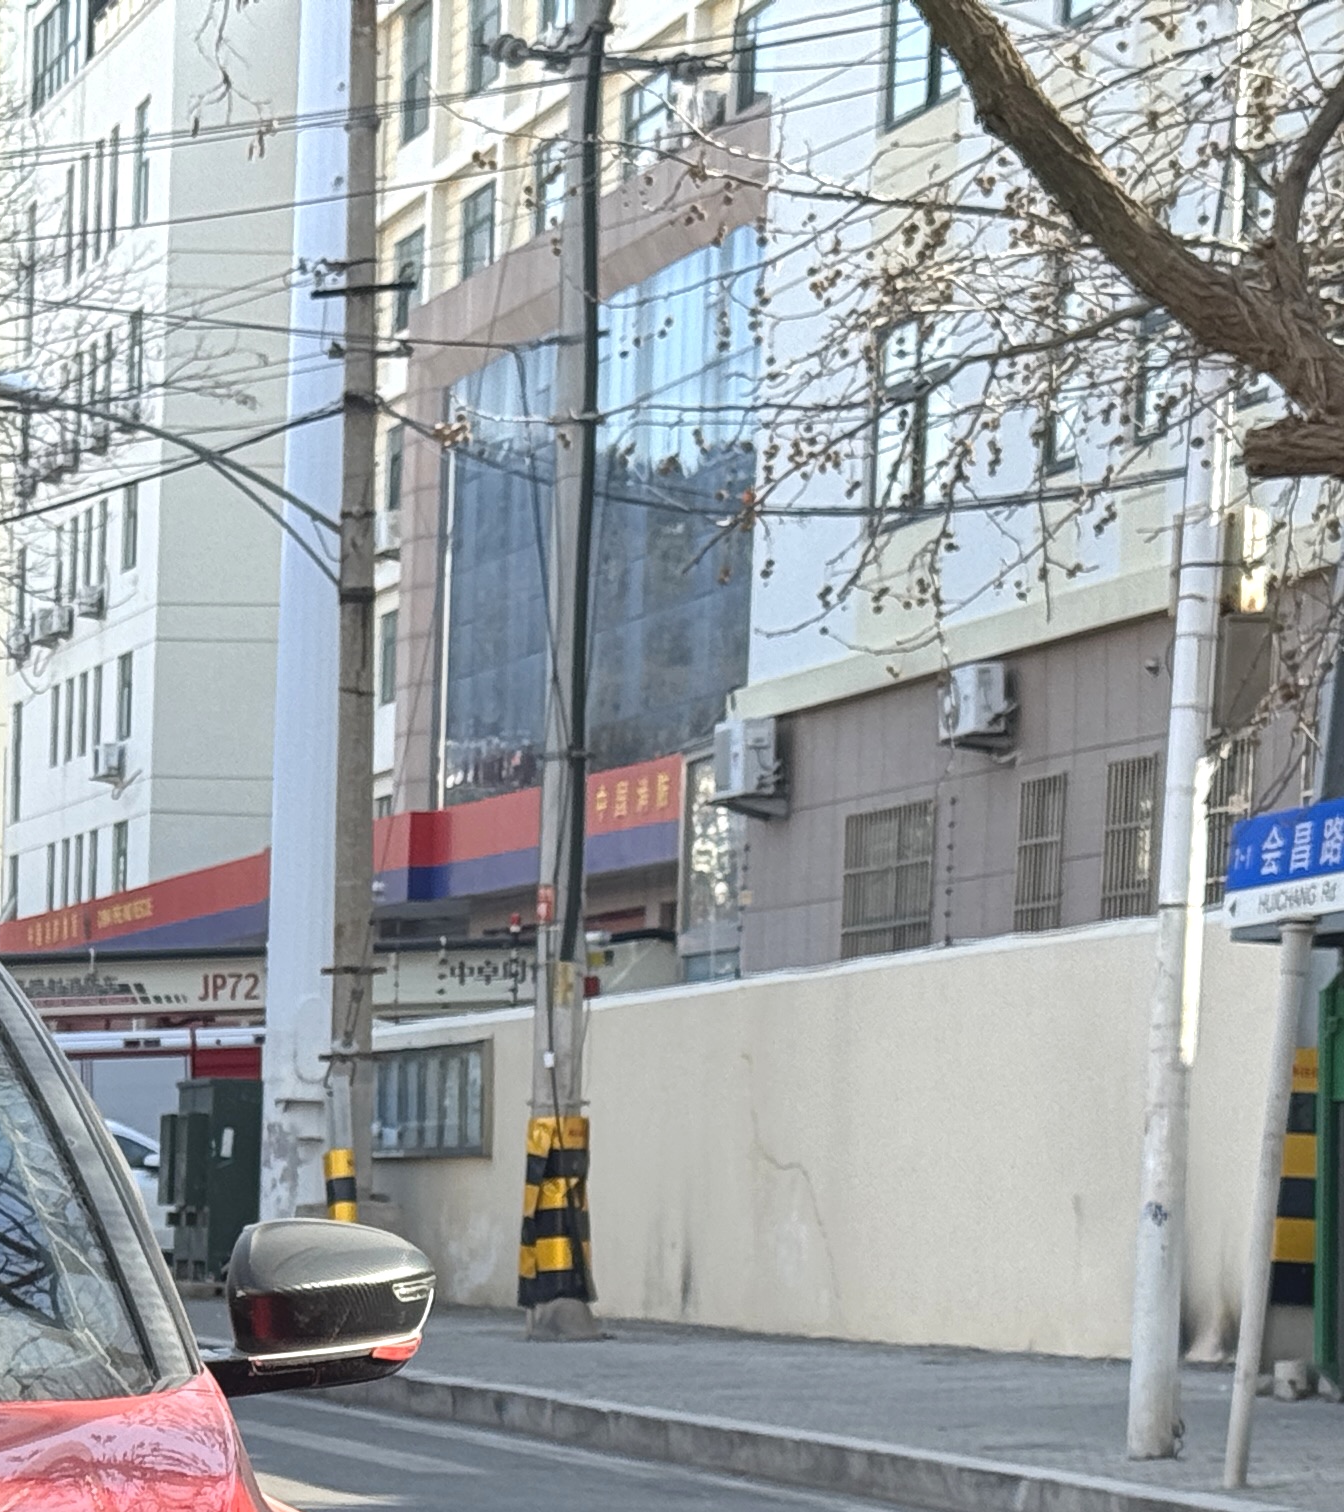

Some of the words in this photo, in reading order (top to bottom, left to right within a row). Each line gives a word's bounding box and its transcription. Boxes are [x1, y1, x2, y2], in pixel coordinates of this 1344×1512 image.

[1260, 814, 1344, 875] 会昌路
[198, 973, 261, 1001] JP72
